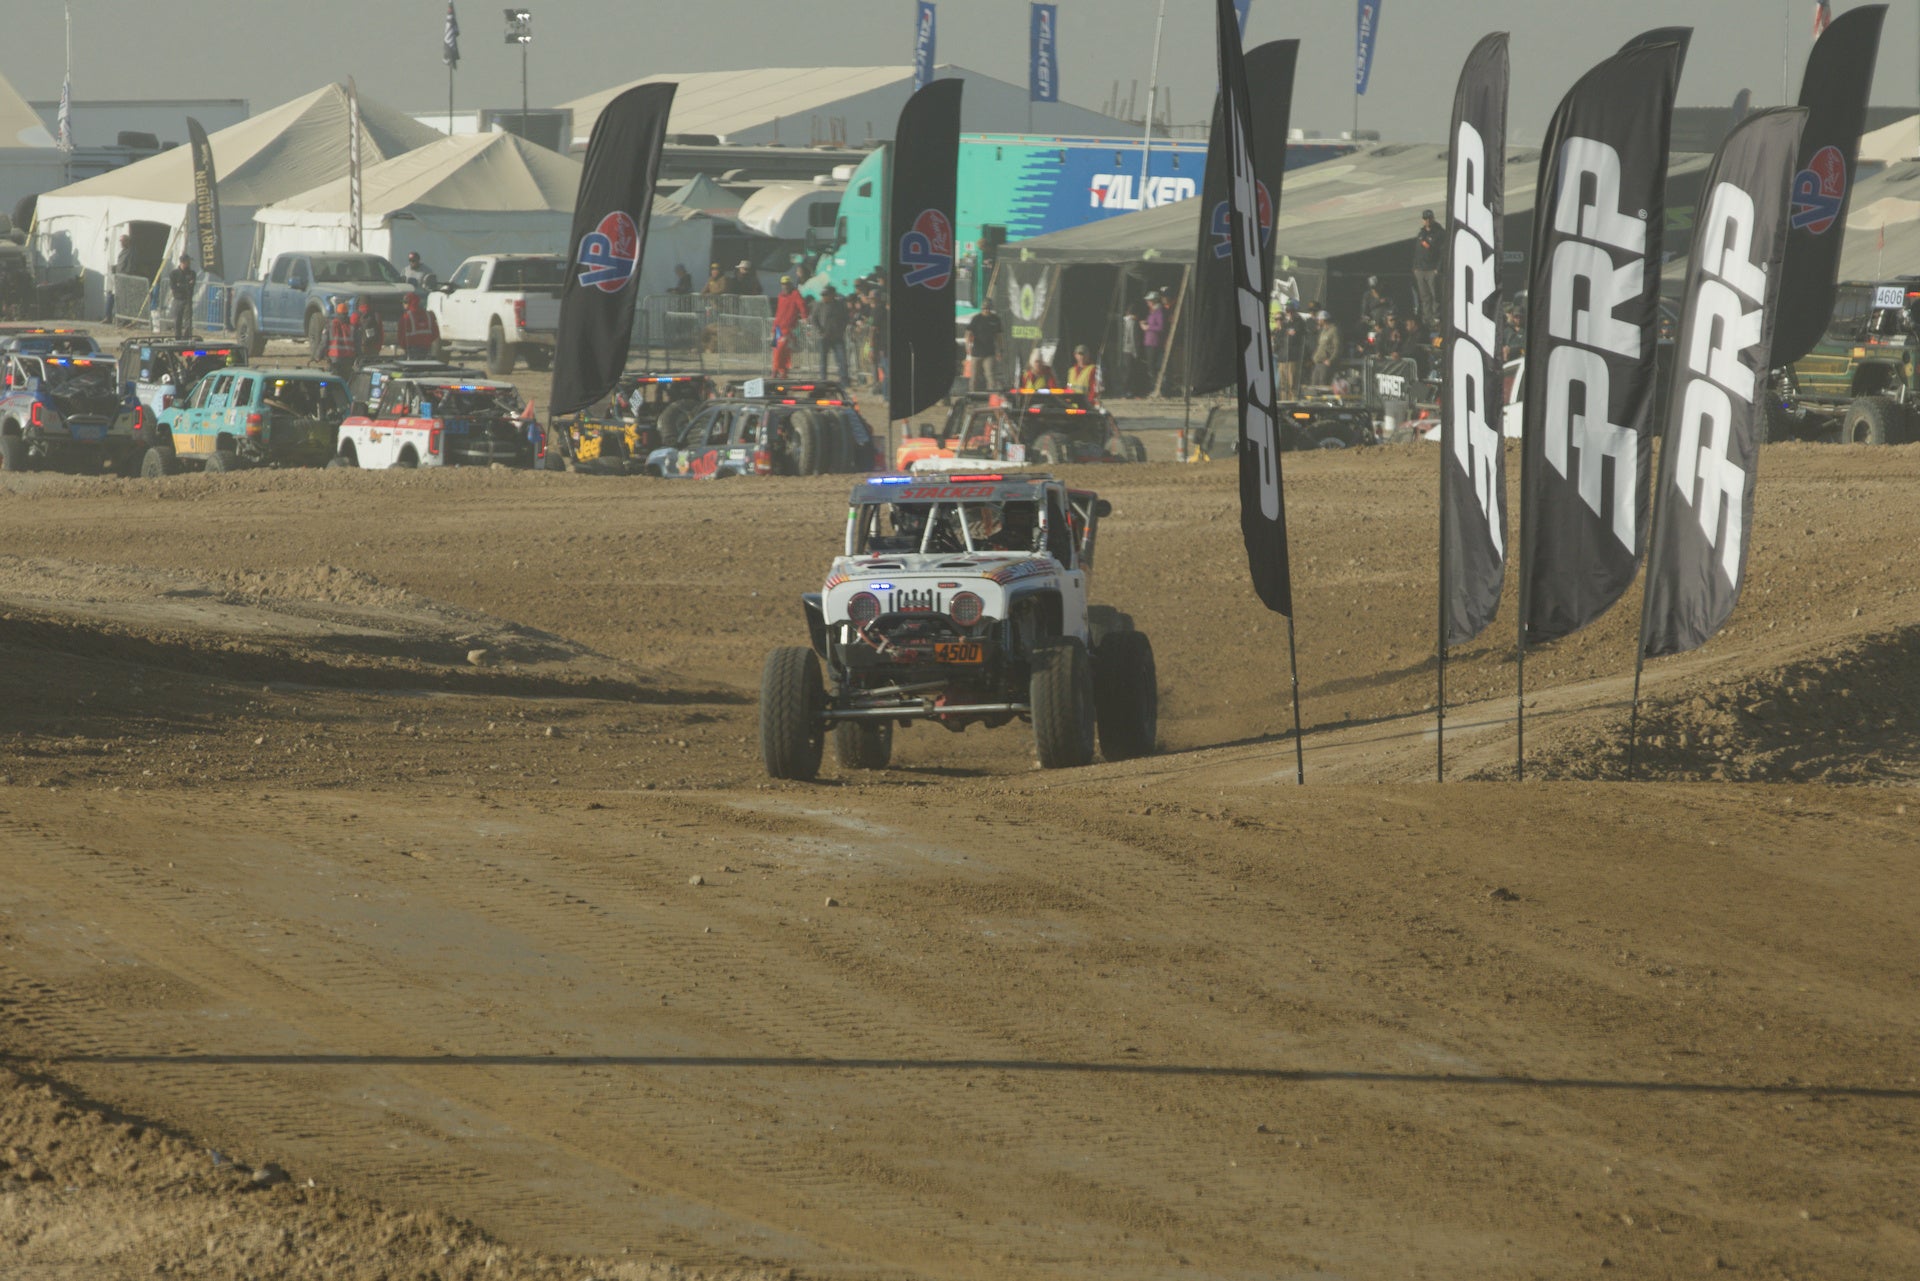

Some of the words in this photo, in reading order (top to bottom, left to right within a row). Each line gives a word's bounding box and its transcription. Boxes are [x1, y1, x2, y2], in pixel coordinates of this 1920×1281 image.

[1037, 9, 1051, 97] FALKEN
[1355, 4, 1373, 84] FALKEN
[195, 170, 212, 225] MADDEN
[1088, 174, 1196, 210] FALKEN
[1791, 168, 1843, 229] VP
[199, 228, 215, 268] TERRY
[577, 231, 634, 287] VP
[899, 230, 953, 287] VP
[1231, 88, 1280, 521] PRP
[1878, 289, 1903, 305] 4606
[1452, 121, 1504, 562] PRP
[1544, 136, 1648, 555] PRP
[1675, 182, 1767, 589] PRP
[899, 486, 996, 500] STACKED
[938, 644, 979, 661] 4500
